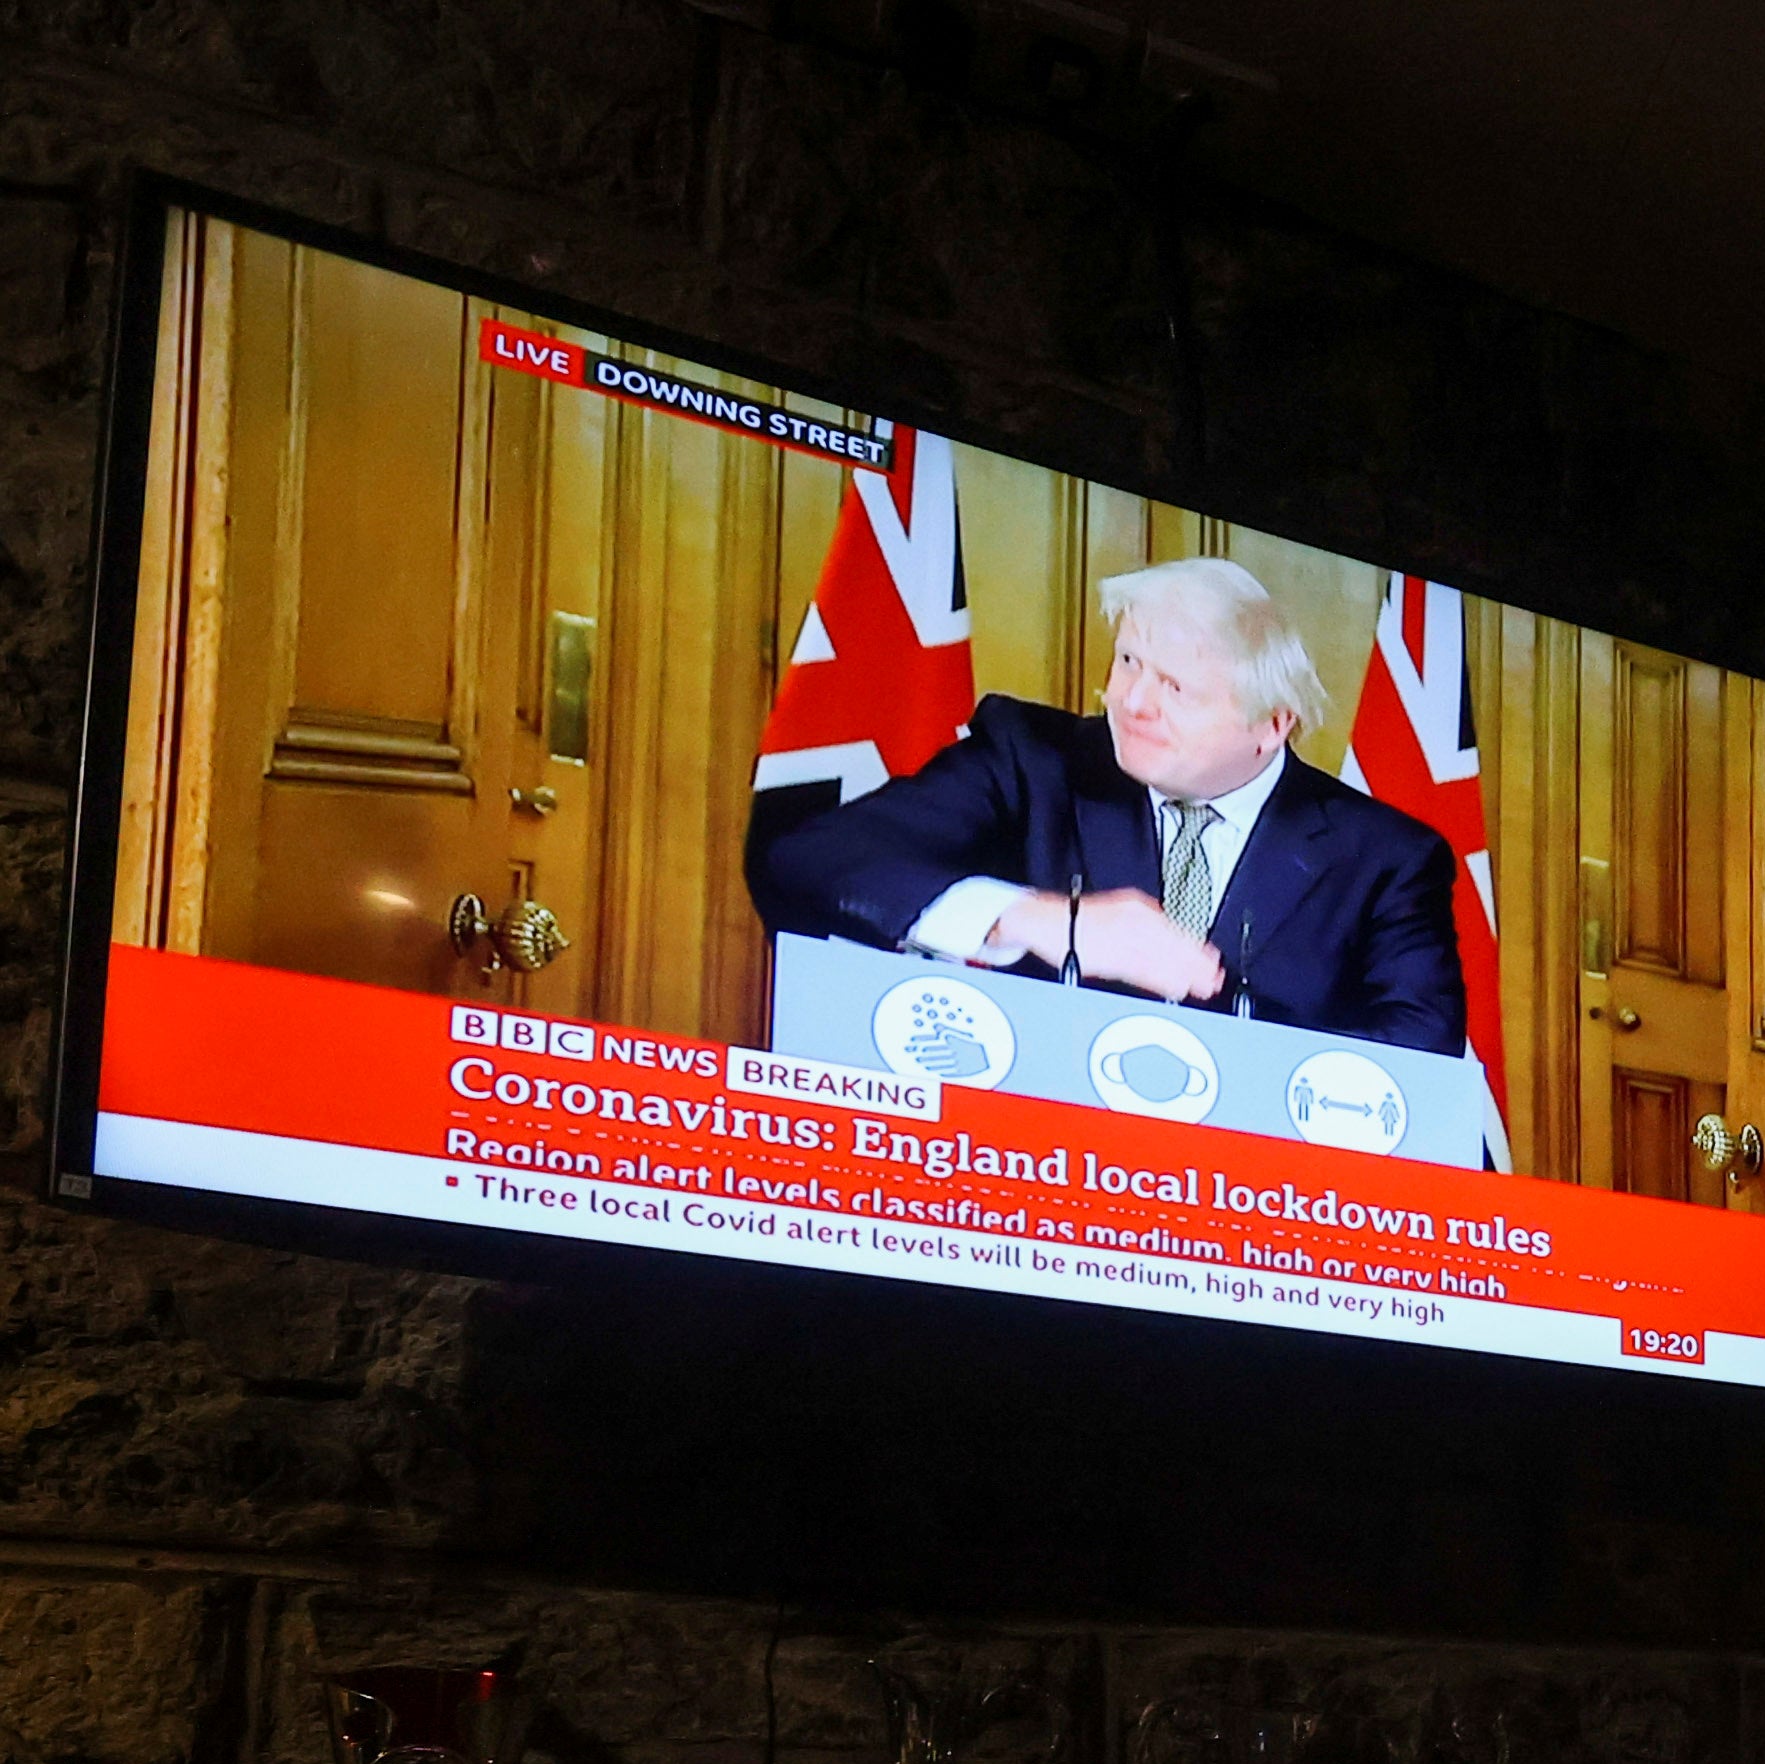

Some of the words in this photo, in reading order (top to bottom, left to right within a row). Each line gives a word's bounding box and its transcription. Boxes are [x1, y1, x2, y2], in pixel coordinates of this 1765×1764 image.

[495, 334, 570, 375] LIVE
[598, 361, 762, 429] DOWNING
[769, 413, 886, 464] STREET
[460, 1011, 588, 1056] BBC
[602, 1034, 718, 1078] NEWS
[742, 1059, 926, 1110] BREAKING
[449, 1056, 837, 1151] Coronavirus:
[851, 1117, 1070, 1187] England
[1082, 1152, 1200, 1206] local
[1211, 1172, 1434, 1241] lockdown
[1446, 1216, 1552, 1257] rules
[447, 1128, 601, 1175] Region
[612, 1154, 712, 1190] alert
[724, 1166, 841, 1208] levels
[850, 1187, 1026, 1234] classified
[1035, 1217, 1076, 1240] as
[1242, 1240, 1314, 1273] high
[1321, 1256, 1357, 1278] or
[1440, 1267, 1506, 1299] high
[475, 1173, 578, 1211] Three
[590, 1188, 671, 1222] local
[683, 1203, 776, 1236] Covid
[787, 1218, 861, 1247] alert
[872, 1227, 960, 1260] levels
[970, 1244, 1021, 1269] will
[1031, 1247, 1066, 1274] be
[1075, 1259, 1196, 1294] medium,
[1206, 1272, 1264, 1303] high
[1272, 1285, 1320, 1307] and
[1328, 1293, 1384, 1321] very
[1391, 1296, 1446, 1326] high
[1629, 1328, 1699, 1359] 19:20
